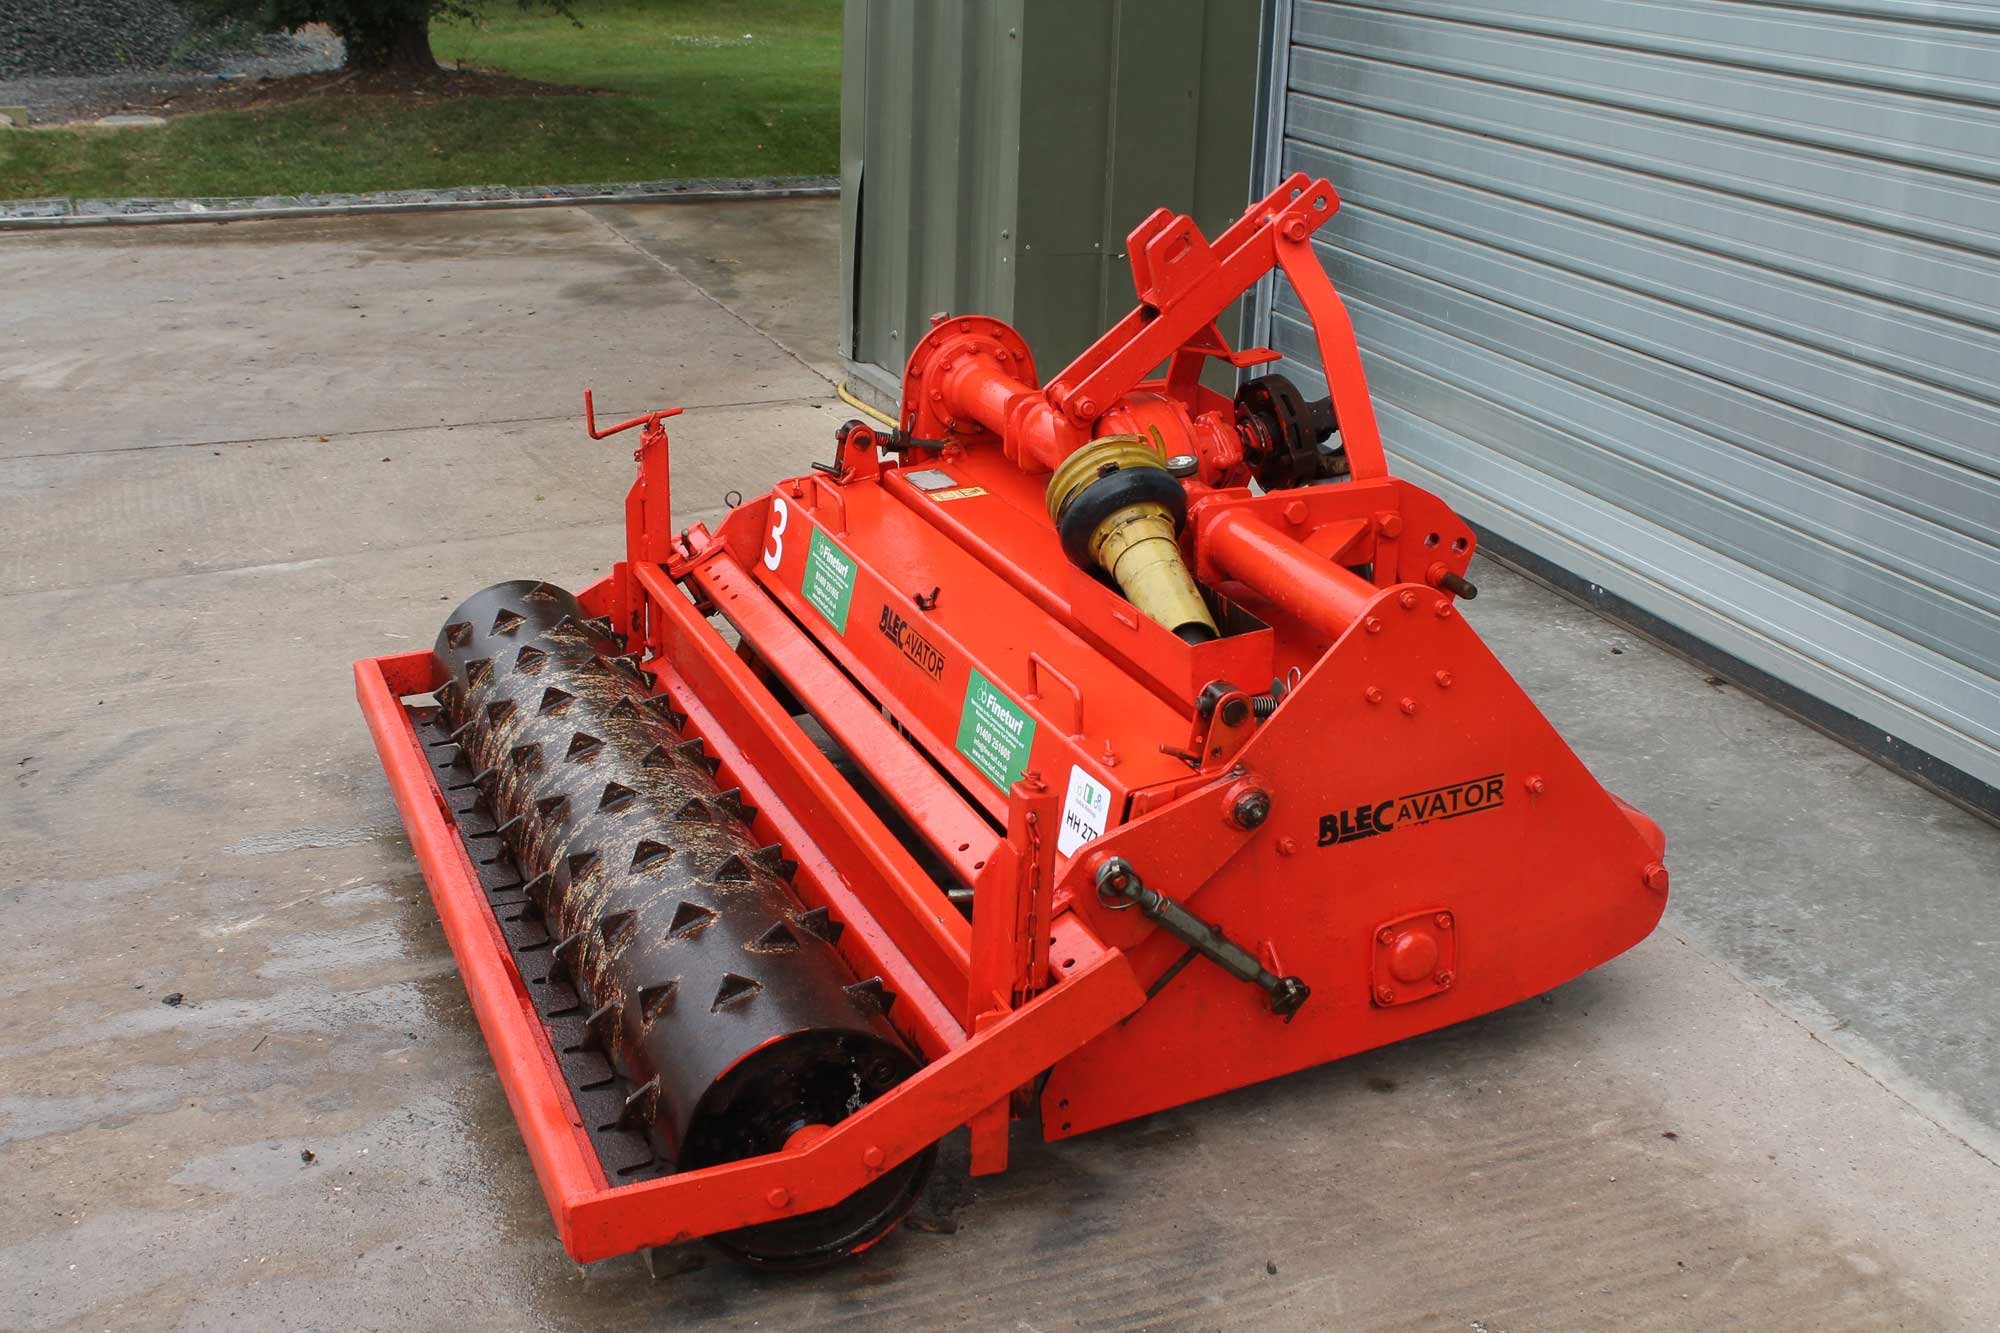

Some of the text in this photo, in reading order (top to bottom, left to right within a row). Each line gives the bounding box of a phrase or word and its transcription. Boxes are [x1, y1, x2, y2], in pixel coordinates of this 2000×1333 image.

[764, 498, 788, 571] 3
[823, 545, 849, 579] Fineturf
[879, 604, 945, 681] BLECAVATOR
[976, 722, 992, 744] 01400
[986, 693, 1024, 736] Fineturf
[1066, 808, 1082, 833] HH
[1317, 775, 1504, 847] BLECAVATOR
